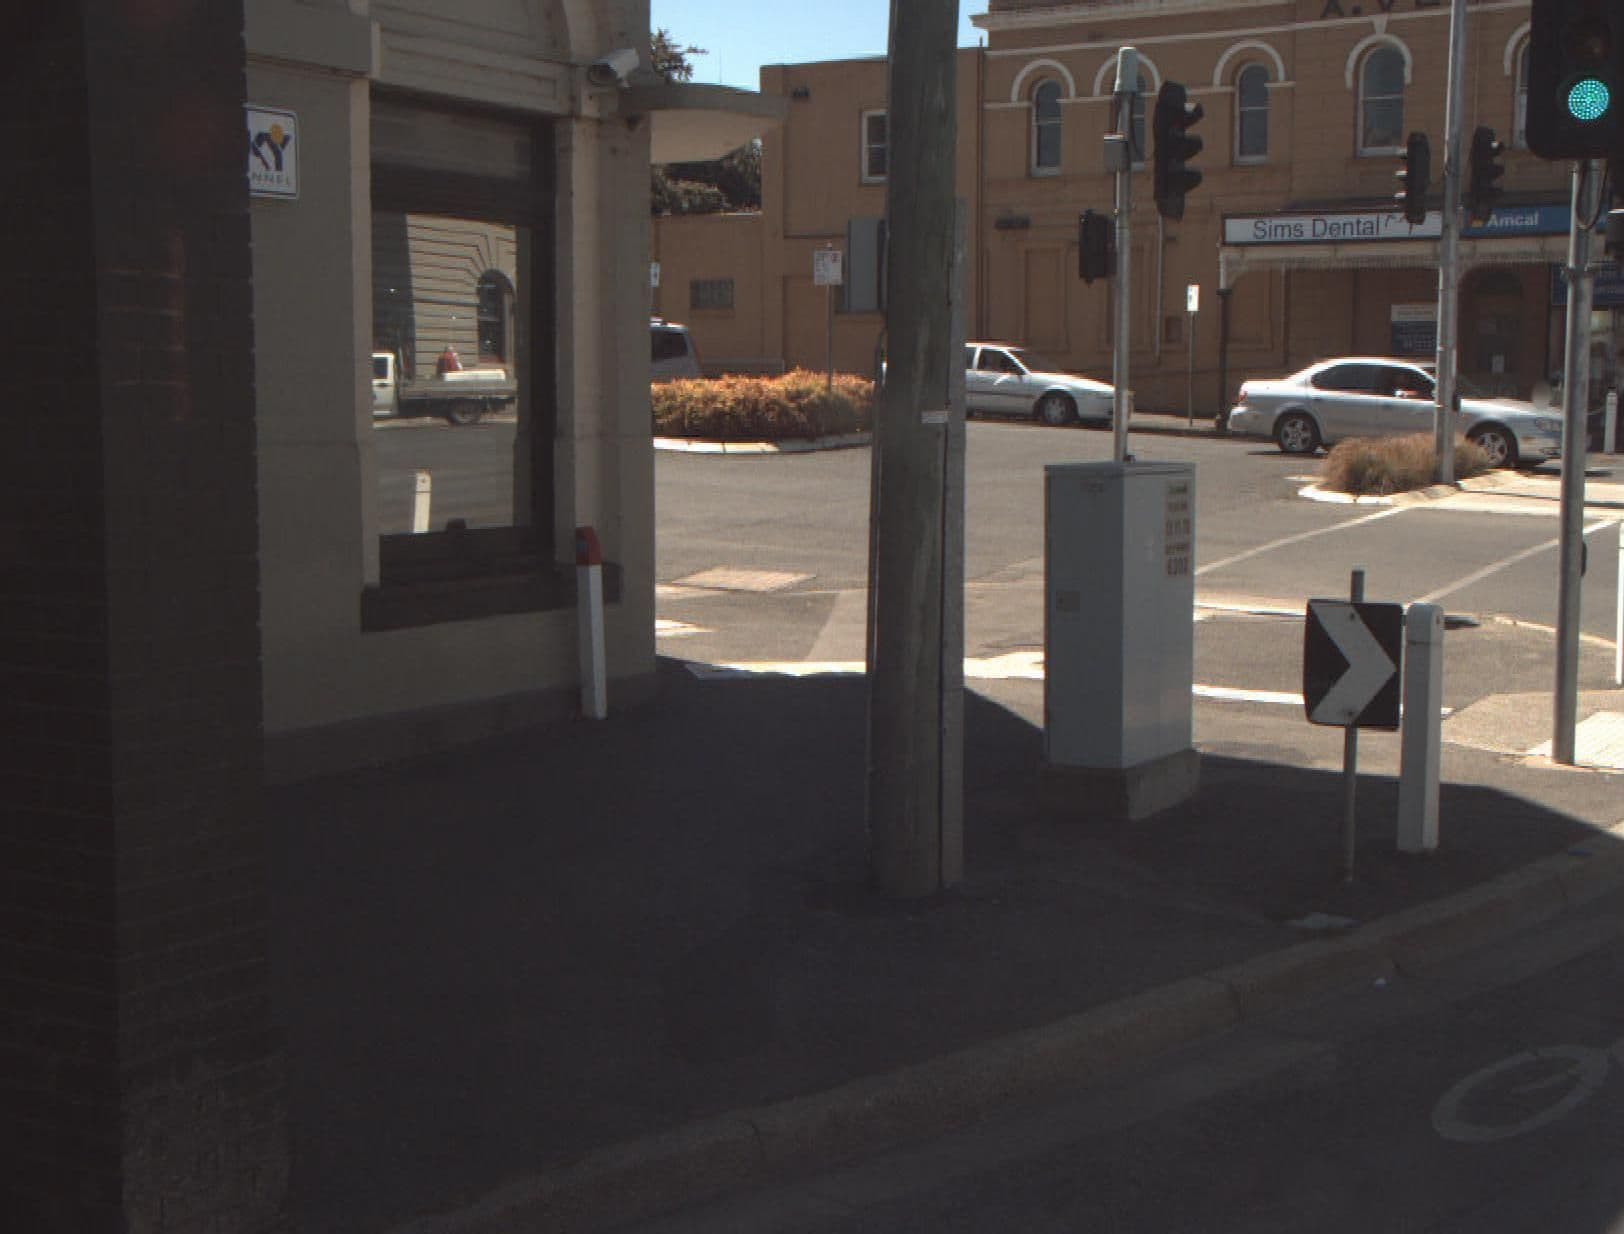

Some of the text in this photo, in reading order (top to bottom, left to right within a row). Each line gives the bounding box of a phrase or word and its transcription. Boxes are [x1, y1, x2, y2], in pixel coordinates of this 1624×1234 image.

[1253, 218, 1304, 240] Sims
[1312, 214, 1379, 239] Dental
[1487, 212, 1539, 227] Amcal
